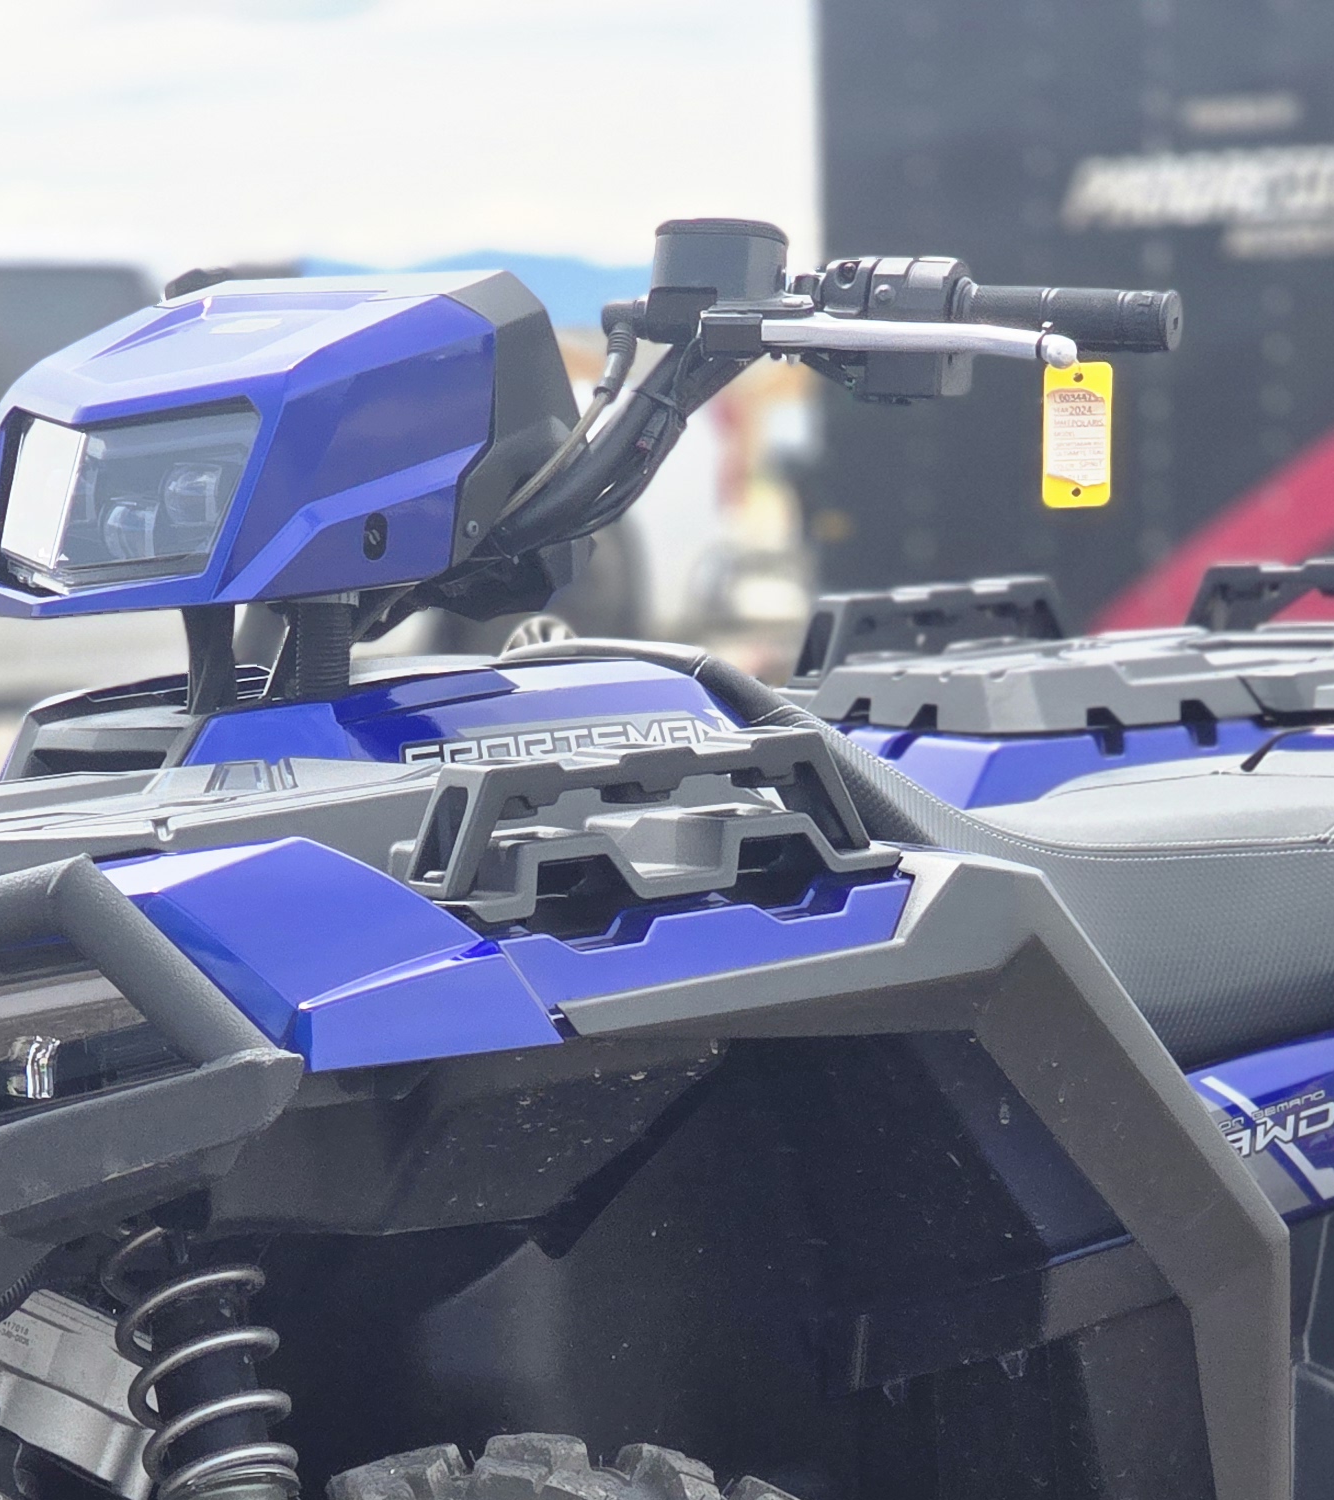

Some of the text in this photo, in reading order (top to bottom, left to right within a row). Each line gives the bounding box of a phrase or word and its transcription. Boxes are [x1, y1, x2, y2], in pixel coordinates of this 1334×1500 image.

[1069, 405, 1093, 416] 2024
[404, 716, 729, 765] SPORTSMAN
[1251, 1089, 1326, 1121] DEMAND
